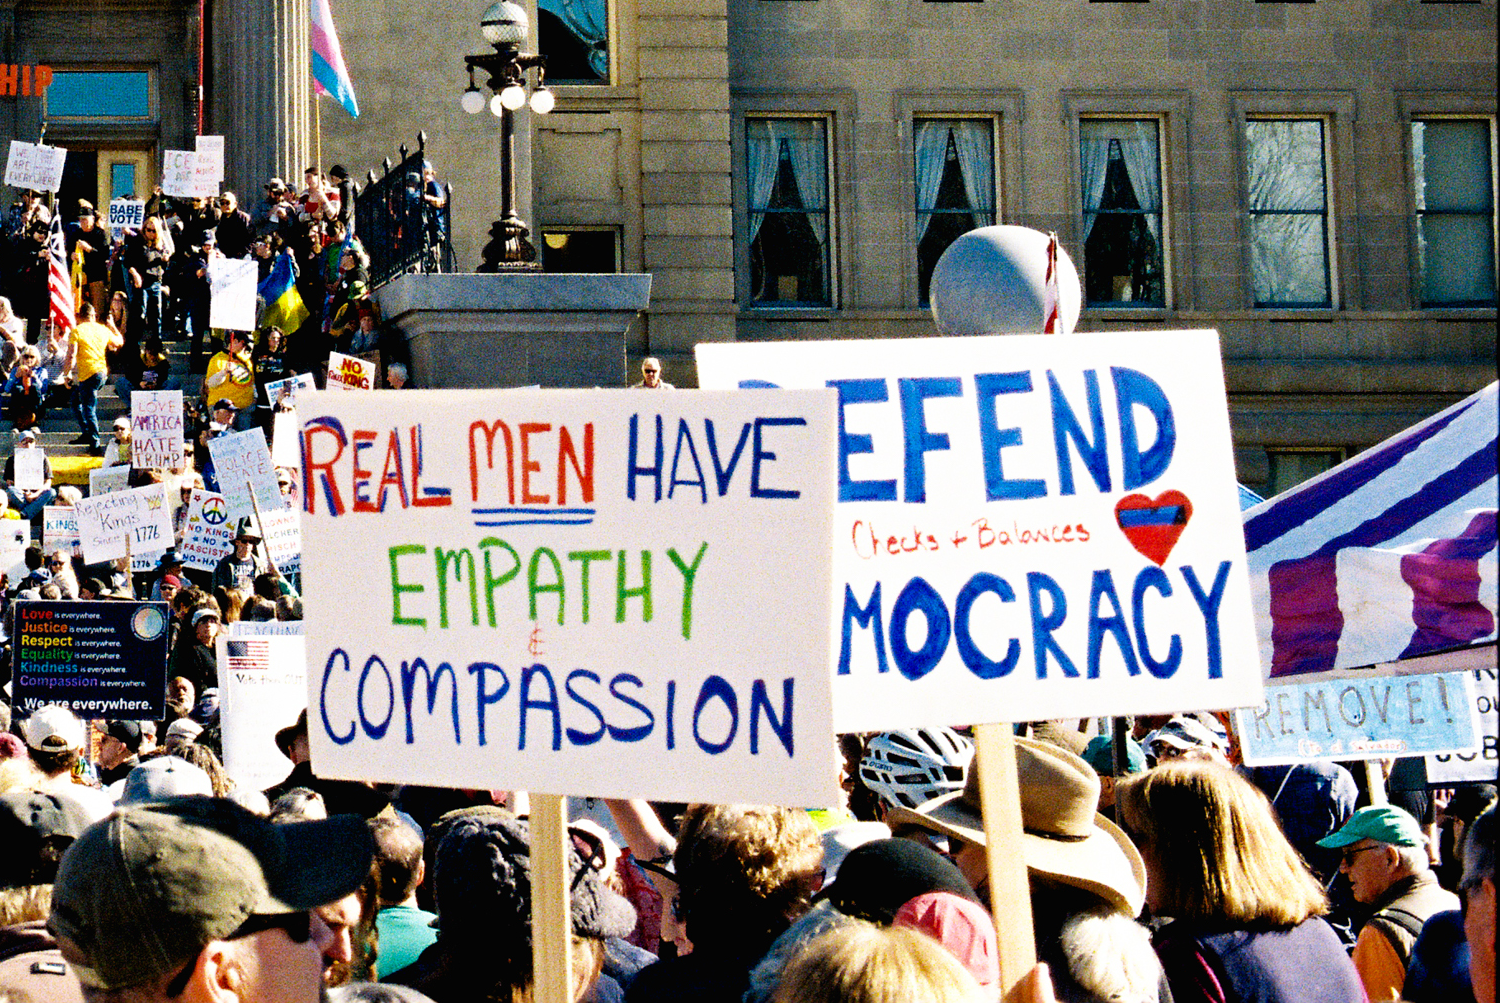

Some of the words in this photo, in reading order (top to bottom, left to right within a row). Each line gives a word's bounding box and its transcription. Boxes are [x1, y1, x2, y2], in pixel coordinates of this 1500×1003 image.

[109, 204, 143, 215] BABE
[109, 214, 143, 225] VOTE
[341, 357, 362, 374] NO
[343, 372, 370, 391] KING
[138, 400, 178, 414] LOVE
[132, 414, 182, 431] AMERICA
[737, 365, 1177, 504] EFEND
[134, 437, 178, 453] HATE
[134, 452, 180, 467] TRUMP
[300, 415, 452, 517] REAL
[468, 418, 595, 505] MEN
[626, 412, 807, 505] HAVE
[74, 494, 139, 520] Rejecting
[135, 524, 161, 543] 1776
[187, 523, 202, 533] NO
[205, 527, 235, 540] KINGS
[852, 518, 941, 560] Checks
[950, 532, 973, 549] +
[202, 536, 217, 546] NO
[182, 553, 196, 562] NO
[183, 543, 230, 557] FASCISTS
[132, 560, 151, 568] 1776
[387, 536, 710, 641] EMPATHY
[21, 608, 53, 620] Love
[60, 612, 102, 622] everywhere.
[837, 559, 1233, 682] MOCRACY
[21, 621, 68, 633] Justice
[75, 626, 116, 635] everywhere.
[21, 635, 73, 648] Respect
[81, 640, 122, 649] everywhere.
[20, 648, 74, 662] Equality
[80, 652, 121, 661] everywhere.
[20, 661, 78, 673] Kindness
[87, 666, 127, 675] everywhere.
[19, 675, 98, 688] Compassion
[106, 680, 146, 689] everywhere.
[24, 697, 46, 709] We
[72, 697, 153, 713] everywhere.
[319, 646, 794, 758] COMPASSION
[1254, 676, 1453, 741] REMOVE!
